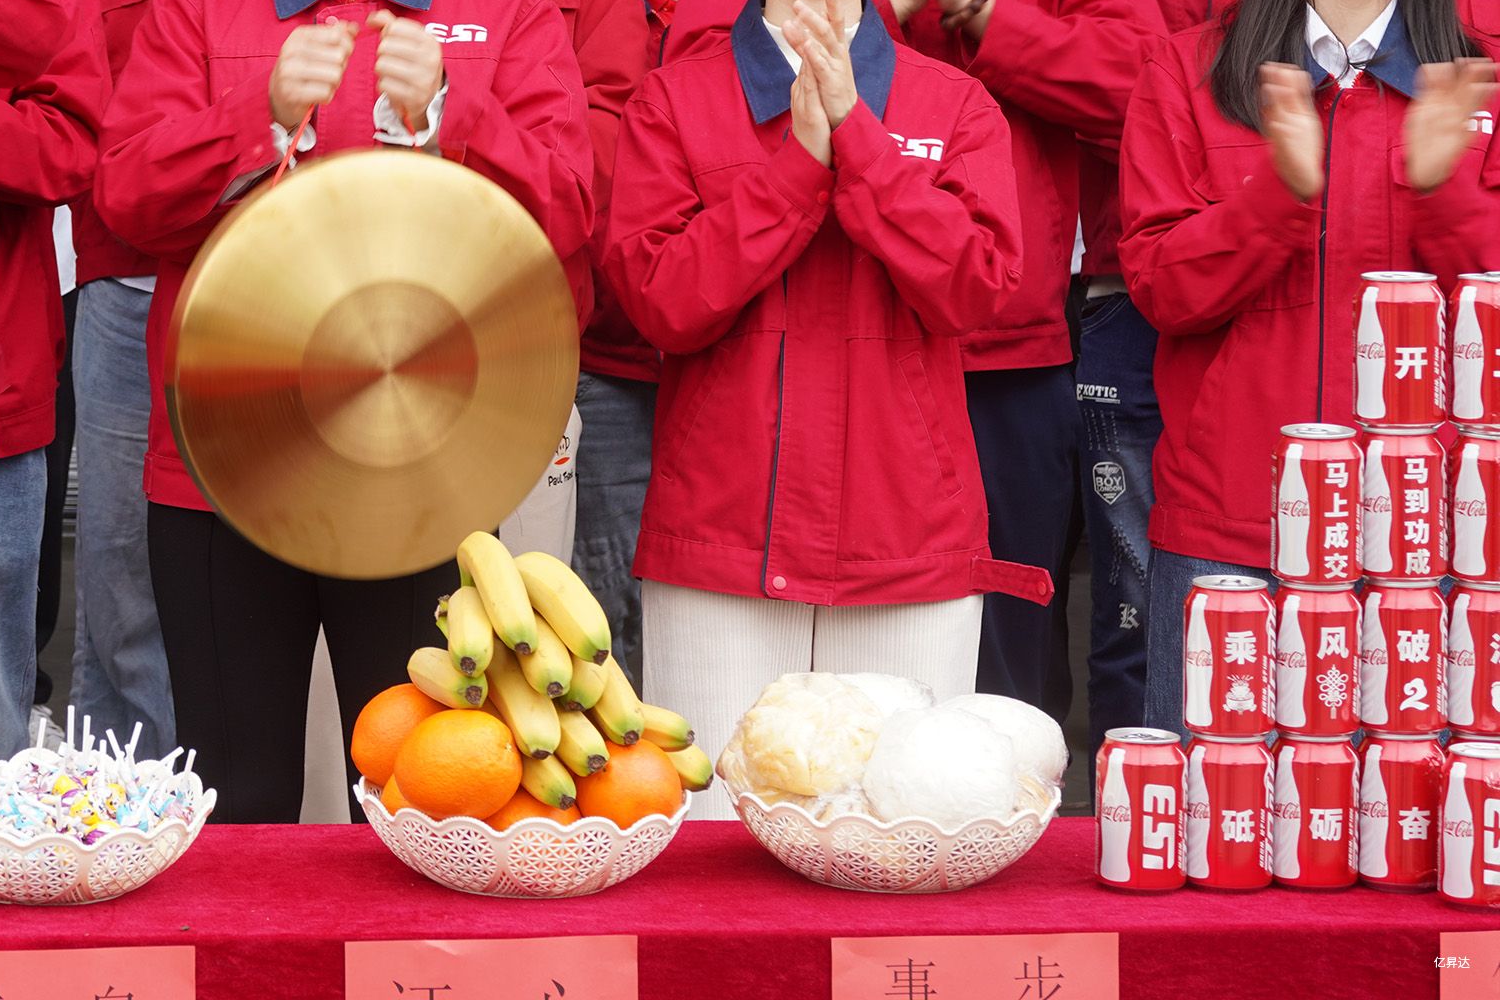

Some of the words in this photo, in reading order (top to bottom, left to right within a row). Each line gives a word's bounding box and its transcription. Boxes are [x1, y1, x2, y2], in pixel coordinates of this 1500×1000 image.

[1394, 347, 1428, 380] 开
[1077, 384, 1118, 400] EXOTIC
[1095, 476, 1121, 486] BOY
[1324, 462, 1349, 579] 马上成交
[1404, 458, 1430, 575] 马到功成
[1223, 630, 1257, 665] 乘
[1316, 626, 1350, 660] 风
[1397, 629, 1430, 663] 破
[1221, 808, 1256, 843] 砥
[1308, 808, 1343, 841] 砺
[1397, 806, 1431, 840] 奋
